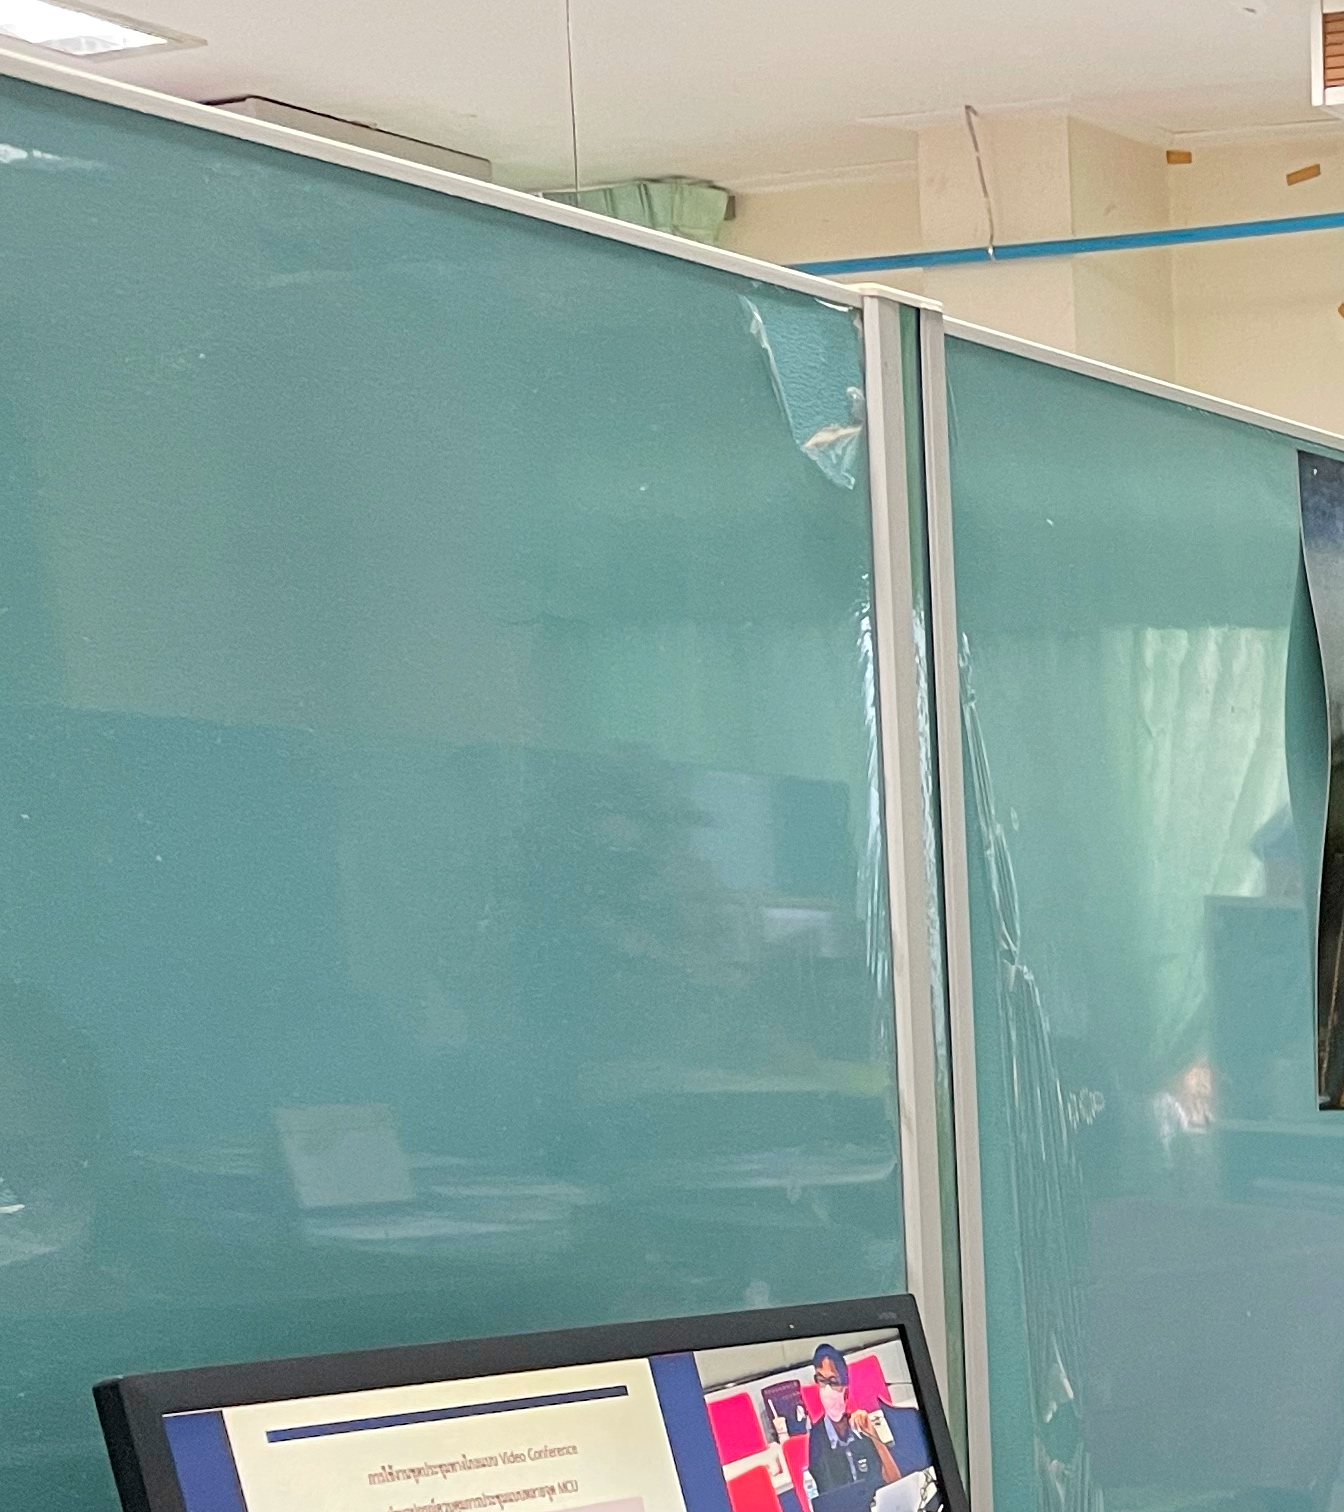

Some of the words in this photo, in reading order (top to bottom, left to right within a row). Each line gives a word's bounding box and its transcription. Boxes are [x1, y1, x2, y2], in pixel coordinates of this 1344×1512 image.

[499, 1449, 527, 1466] Video
[528, 1443, 579, 1463] Conference
[557, 1479, 579, 1496] MCU
